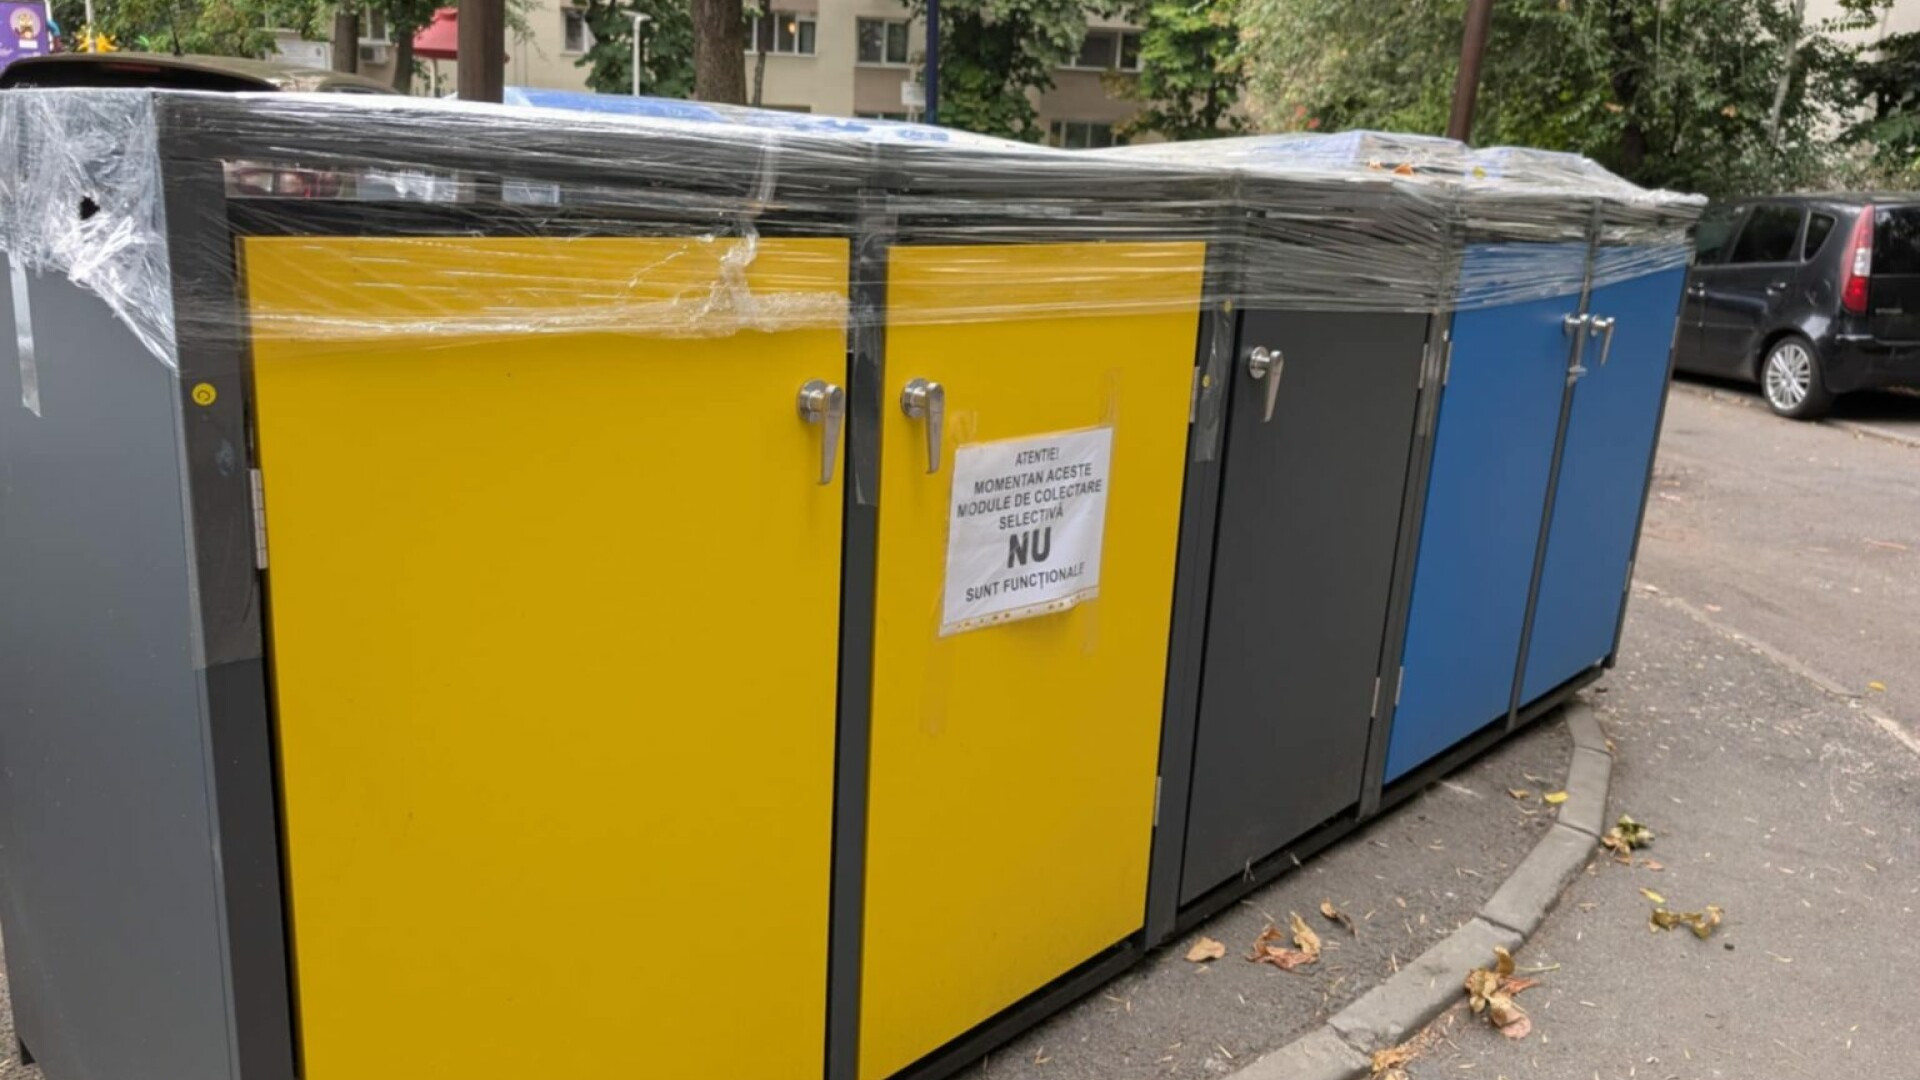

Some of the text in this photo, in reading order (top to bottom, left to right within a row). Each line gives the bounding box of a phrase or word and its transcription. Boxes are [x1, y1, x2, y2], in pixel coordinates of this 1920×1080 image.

[974, 463, 1092, 494] MOMENTAN ACESTE
[957, 479, 1102, 517] MODULE DE COLECTARE
[1007, 527, 1051, 568] NU
[966, 582, 1000, 602] SUNT
